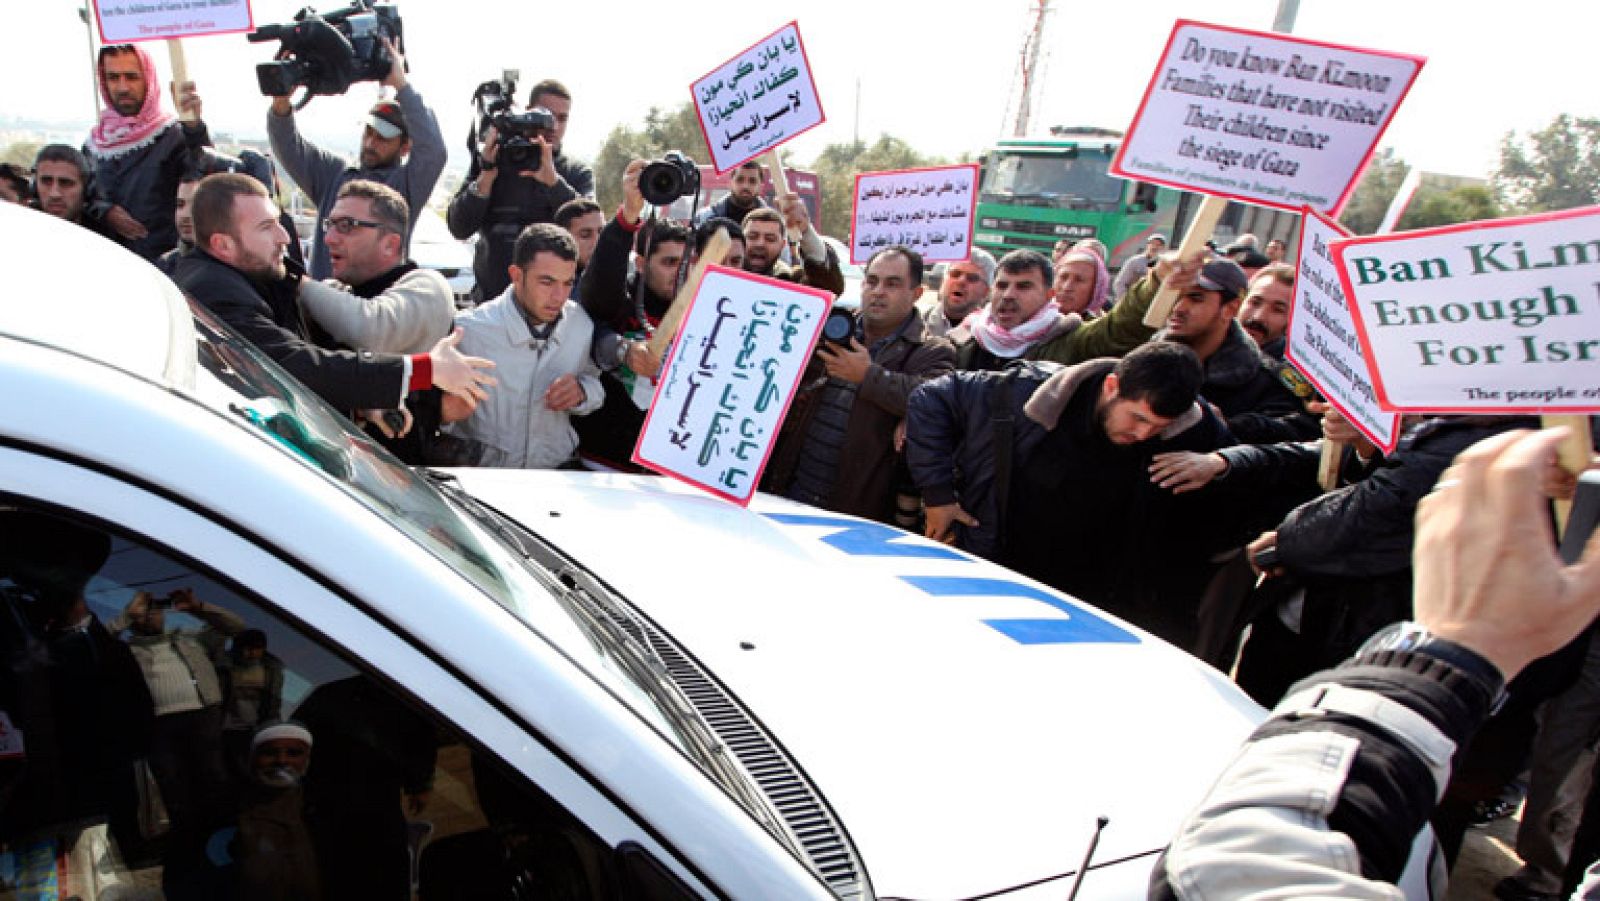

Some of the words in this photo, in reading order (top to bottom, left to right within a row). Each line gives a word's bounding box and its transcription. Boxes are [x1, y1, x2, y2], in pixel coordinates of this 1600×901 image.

[757, 44, 780, 71] بان
[781, 34, 797, 54] يا
[1179, 36, 1206, 62] Do
[1204, 44, 1240, 70] you
[1240, 46, 1286, 75] know
[1282, 54, 1320, 82] Ban
[701, 78, 724, 105] مون
[751, 64, 799, 101] كفاك
[1160, 68, 1228, 100] Families
[1226, 78, 1262, 106] that
[1258, 84, 1299, 112] have
[1296, 95, 1330, 118] not
[1328, 97, 1389, 126] visited
[1183, 103, 1224, 131] Their
[1222, 110, 1288, 144] children
[1286, 125, 1330, 150] since
[1177, 135, 1205, 160] the
[1204, 141, 1244, 171] siege
[1241, 147, 1264, 172] of
[1261, 151, 1301, 177] Gaza
[1054, 224, 1094, 237] DAF
[1350, 255, 1453, 287] Ban
[1370, 285, 1583, 328] Enough
[778, 303, 812, 353] مون
[1315, 335, 1353, 383] Palestinian
[1414, 338, 1505, 367] For
[1464, 386, 1501, 401] The
[1505, 386, 1577, 403] people
[697, 383, 738, 468] كفاك
[730, 417, 764, 462] بان
[719, 466, 749, 490] يا
[758, 512, 1143, 646] UN
